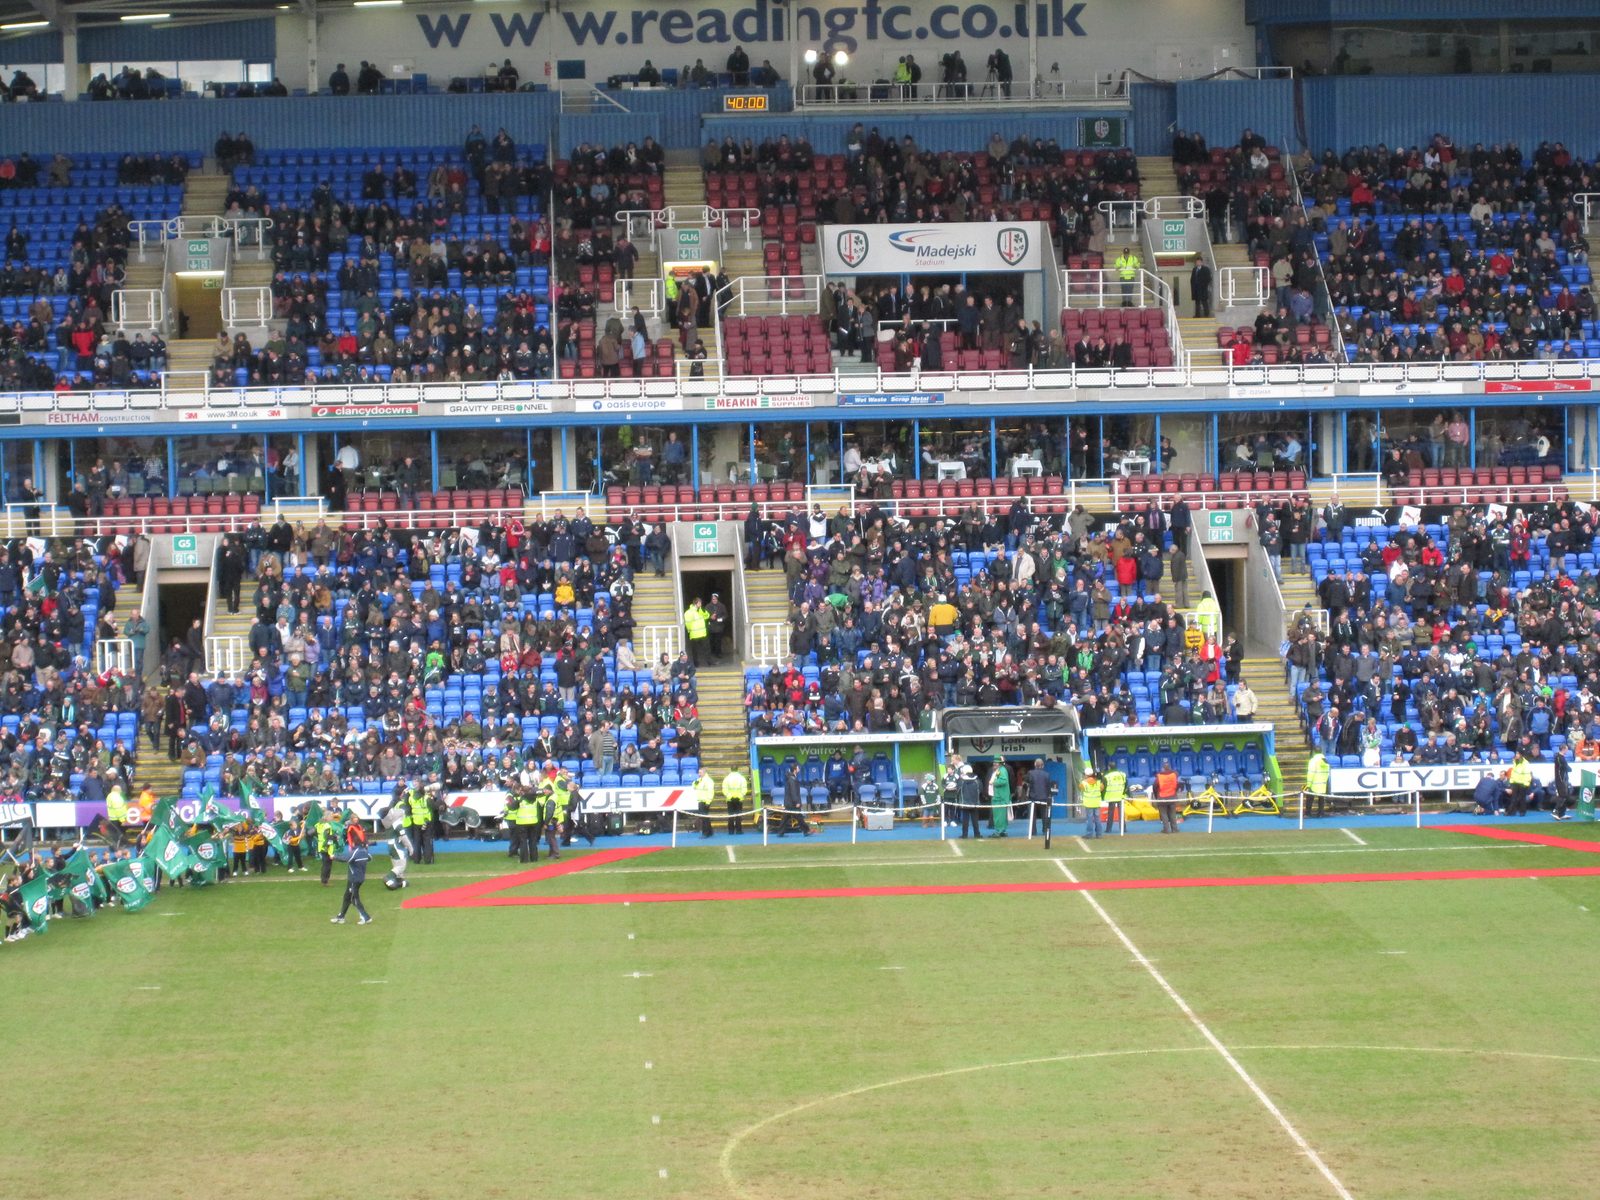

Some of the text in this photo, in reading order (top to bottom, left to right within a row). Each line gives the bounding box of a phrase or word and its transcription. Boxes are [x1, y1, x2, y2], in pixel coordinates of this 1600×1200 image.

[727, 96, 765, 109] 40:00
[1165, 223, 1183, 232] GU7
[680, 233, 699, 242] GU6
[917, 244, 976, 259] Madejski
[450, 402, 548, 412] GRAVITY PERSONNEL
[607, 400, 666, 409] oasis europe
[716, 399, 757, 407] MEAKIN
[207, 410, 258, 418] www.3M.co.uk
[267, 409, 280, 417] 3M
[335, 405, 413, 416] clancydocwra
[48, 412, 151, 423] FELTHAM CONSTRUCTION
[1214, 515, 1227, 524] G7
[698, 527, 712, 535] G6
[178, 539, 191, 548] G5
[1001, 744, 1025, 752] Irish
[1357, 768, 1493, 789] CITYJET
[579, 791, 655, 809] YJET
